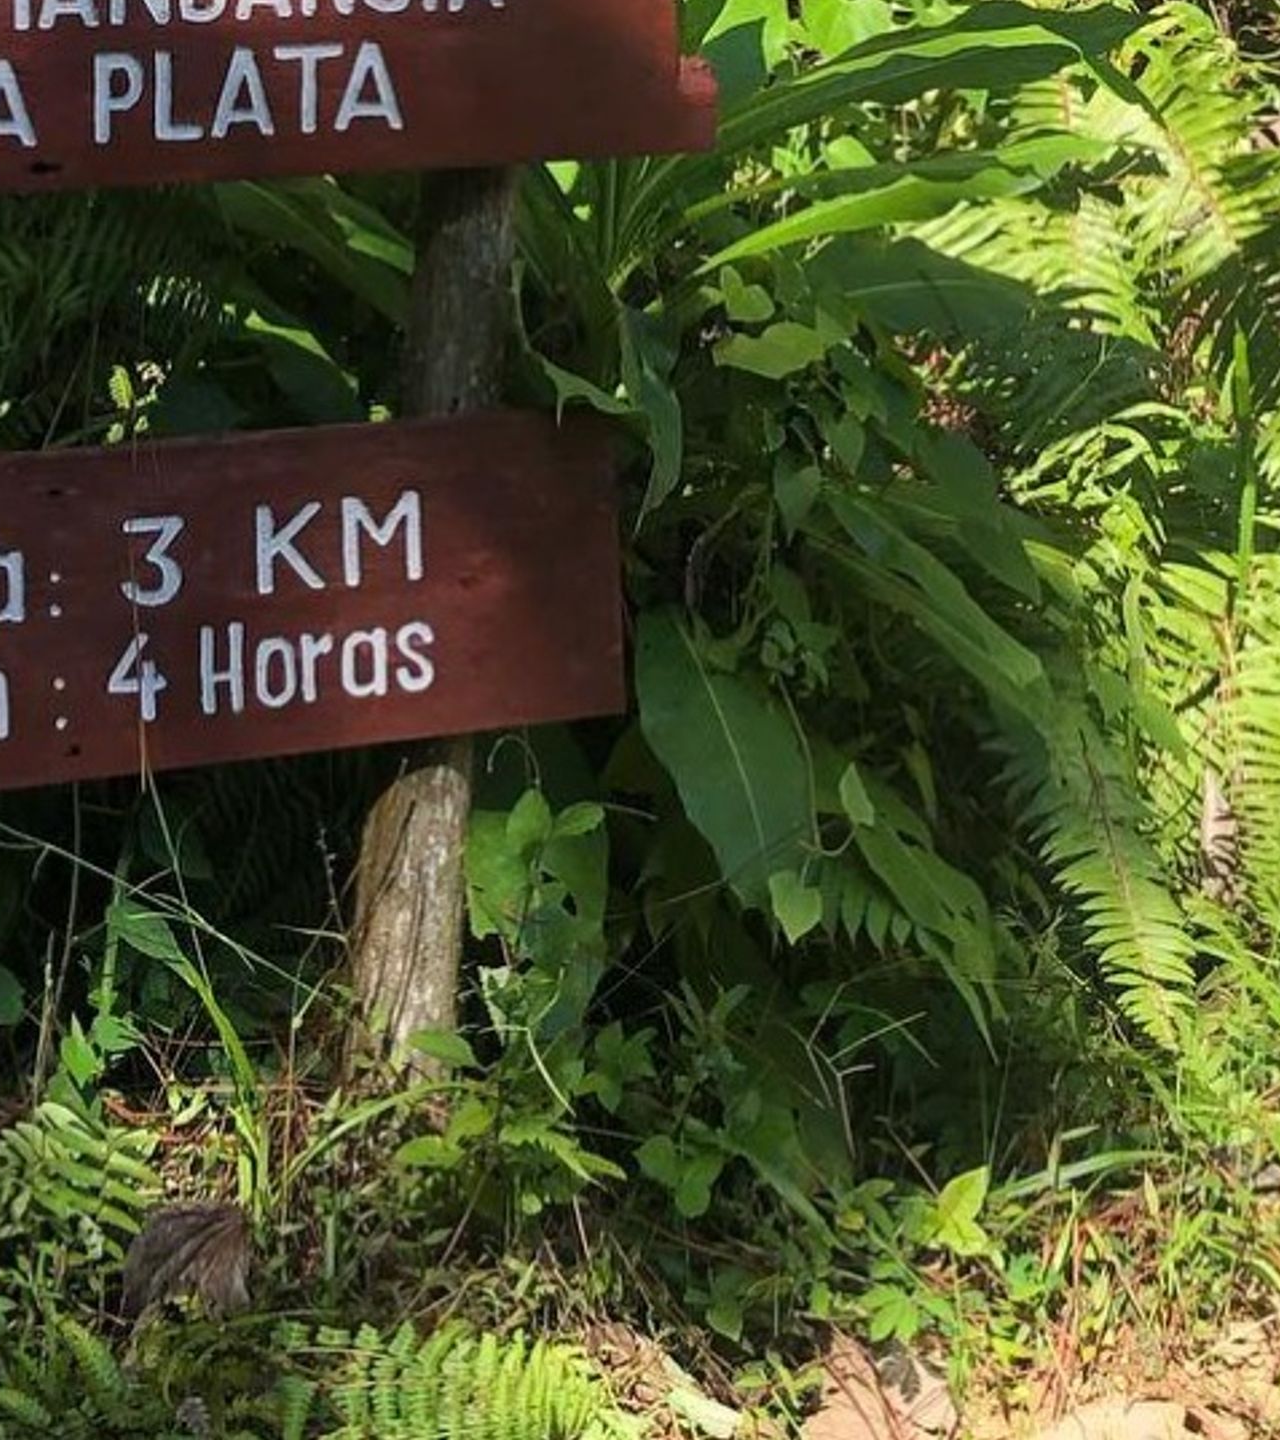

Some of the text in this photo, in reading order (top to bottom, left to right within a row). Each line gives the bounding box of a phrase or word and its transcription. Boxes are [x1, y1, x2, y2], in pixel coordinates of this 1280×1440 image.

[93, 42, 404, 143] PLATA
[122, 515, 185, 607] 3
[255, 489, 424, 595] KM
[107, 632, 168, 722] 4
[199, 621, 436, 715] Horas
